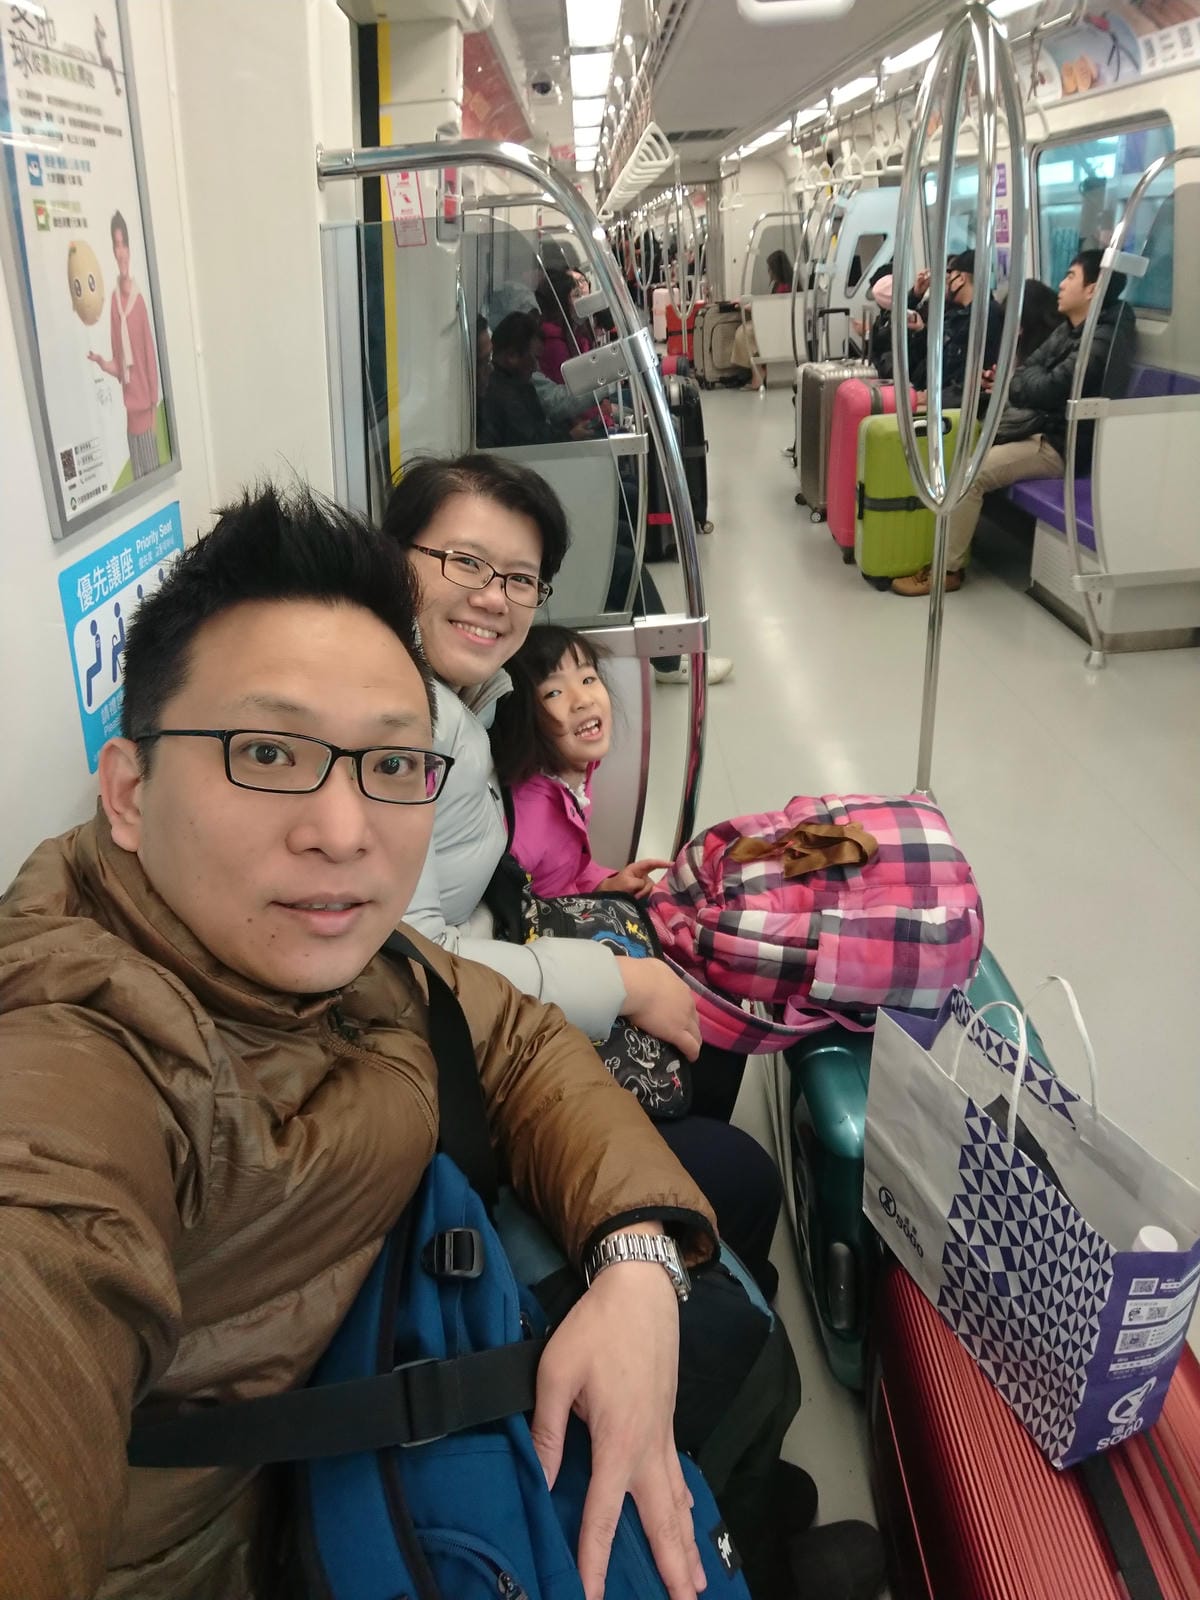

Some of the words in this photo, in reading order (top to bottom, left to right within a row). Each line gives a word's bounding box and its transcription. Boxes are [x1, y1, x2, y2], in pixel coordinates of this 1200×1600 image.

[136, 529, 159, 553] Priority
[159, 520, 172, 538] Seat
[77, 548, 135, 612] 優先讓座
